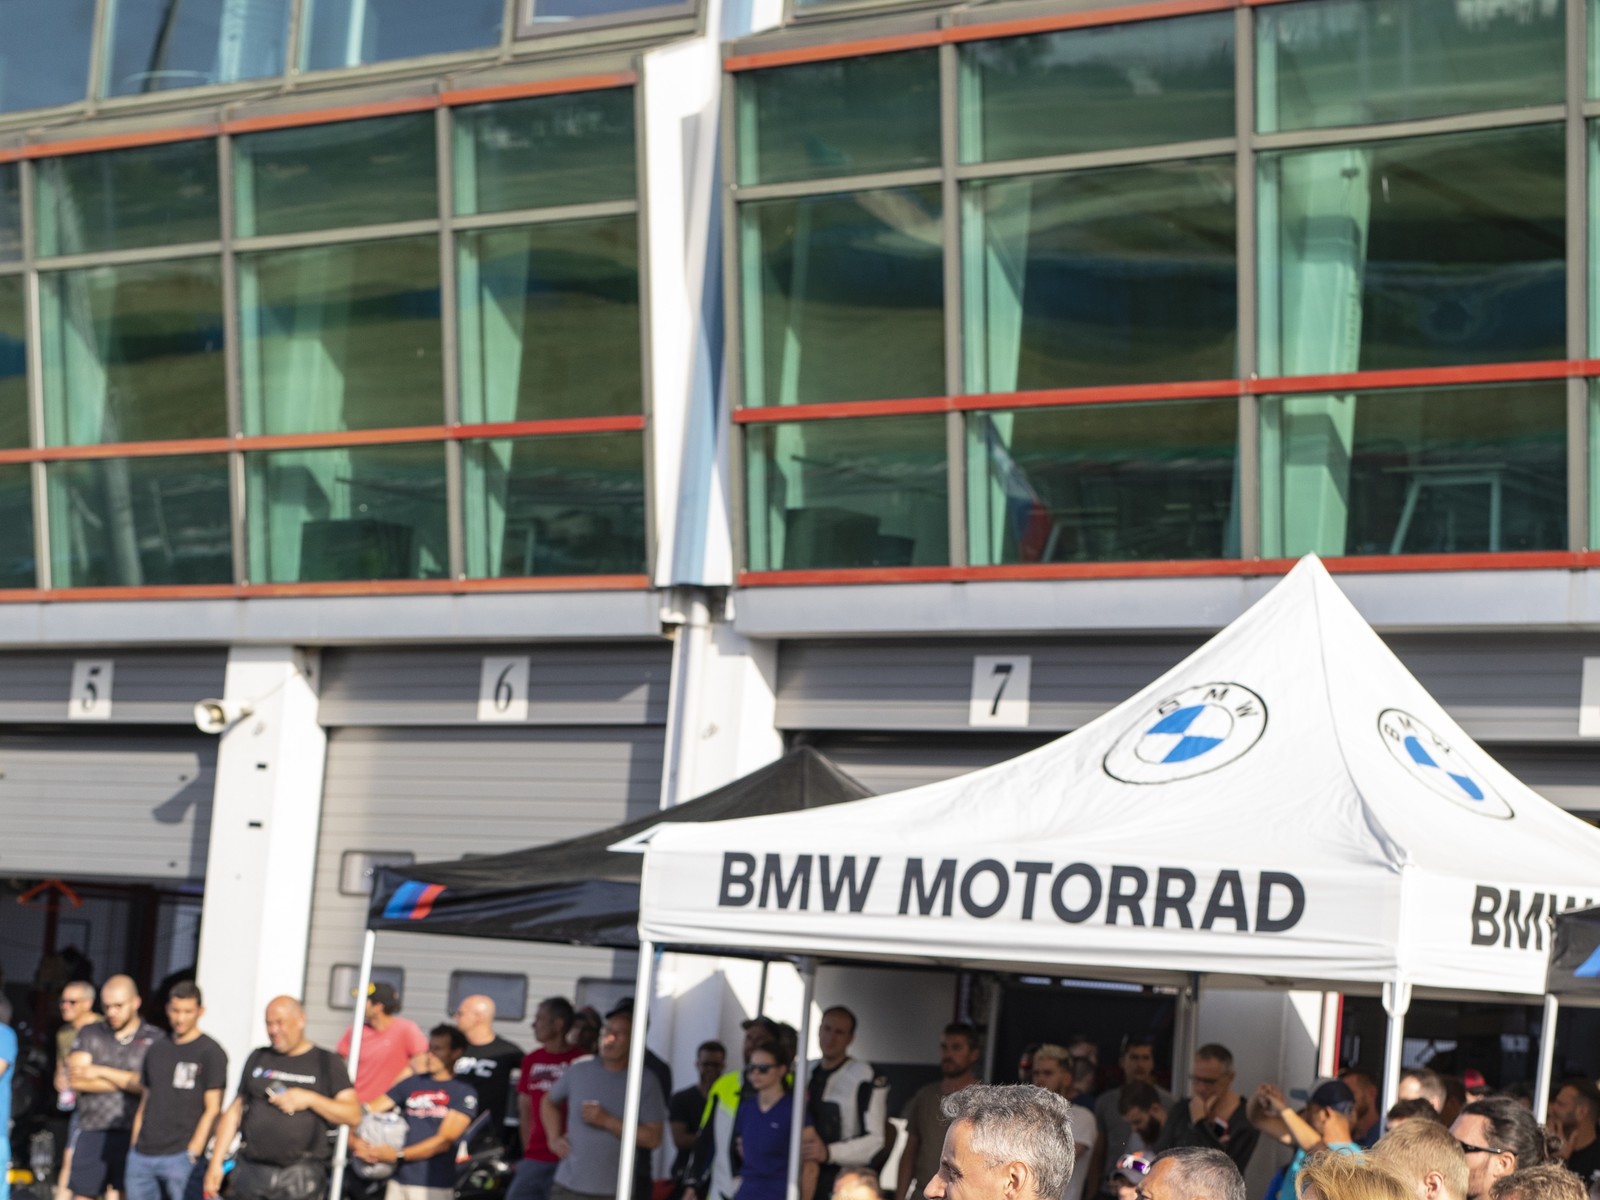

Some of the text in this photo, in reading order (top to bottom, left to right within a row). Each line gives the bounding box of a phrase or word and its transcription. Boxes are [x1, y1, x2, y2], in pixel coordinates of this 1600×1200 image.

[81, 666, 101, 712] 5
[494, 662, 515, 713] 6
[990, 664, 1012, 716] 7
[1158, 688, 1258, 718] BMW
[718, 851, 1305, 932] BMW MOTORRAD
